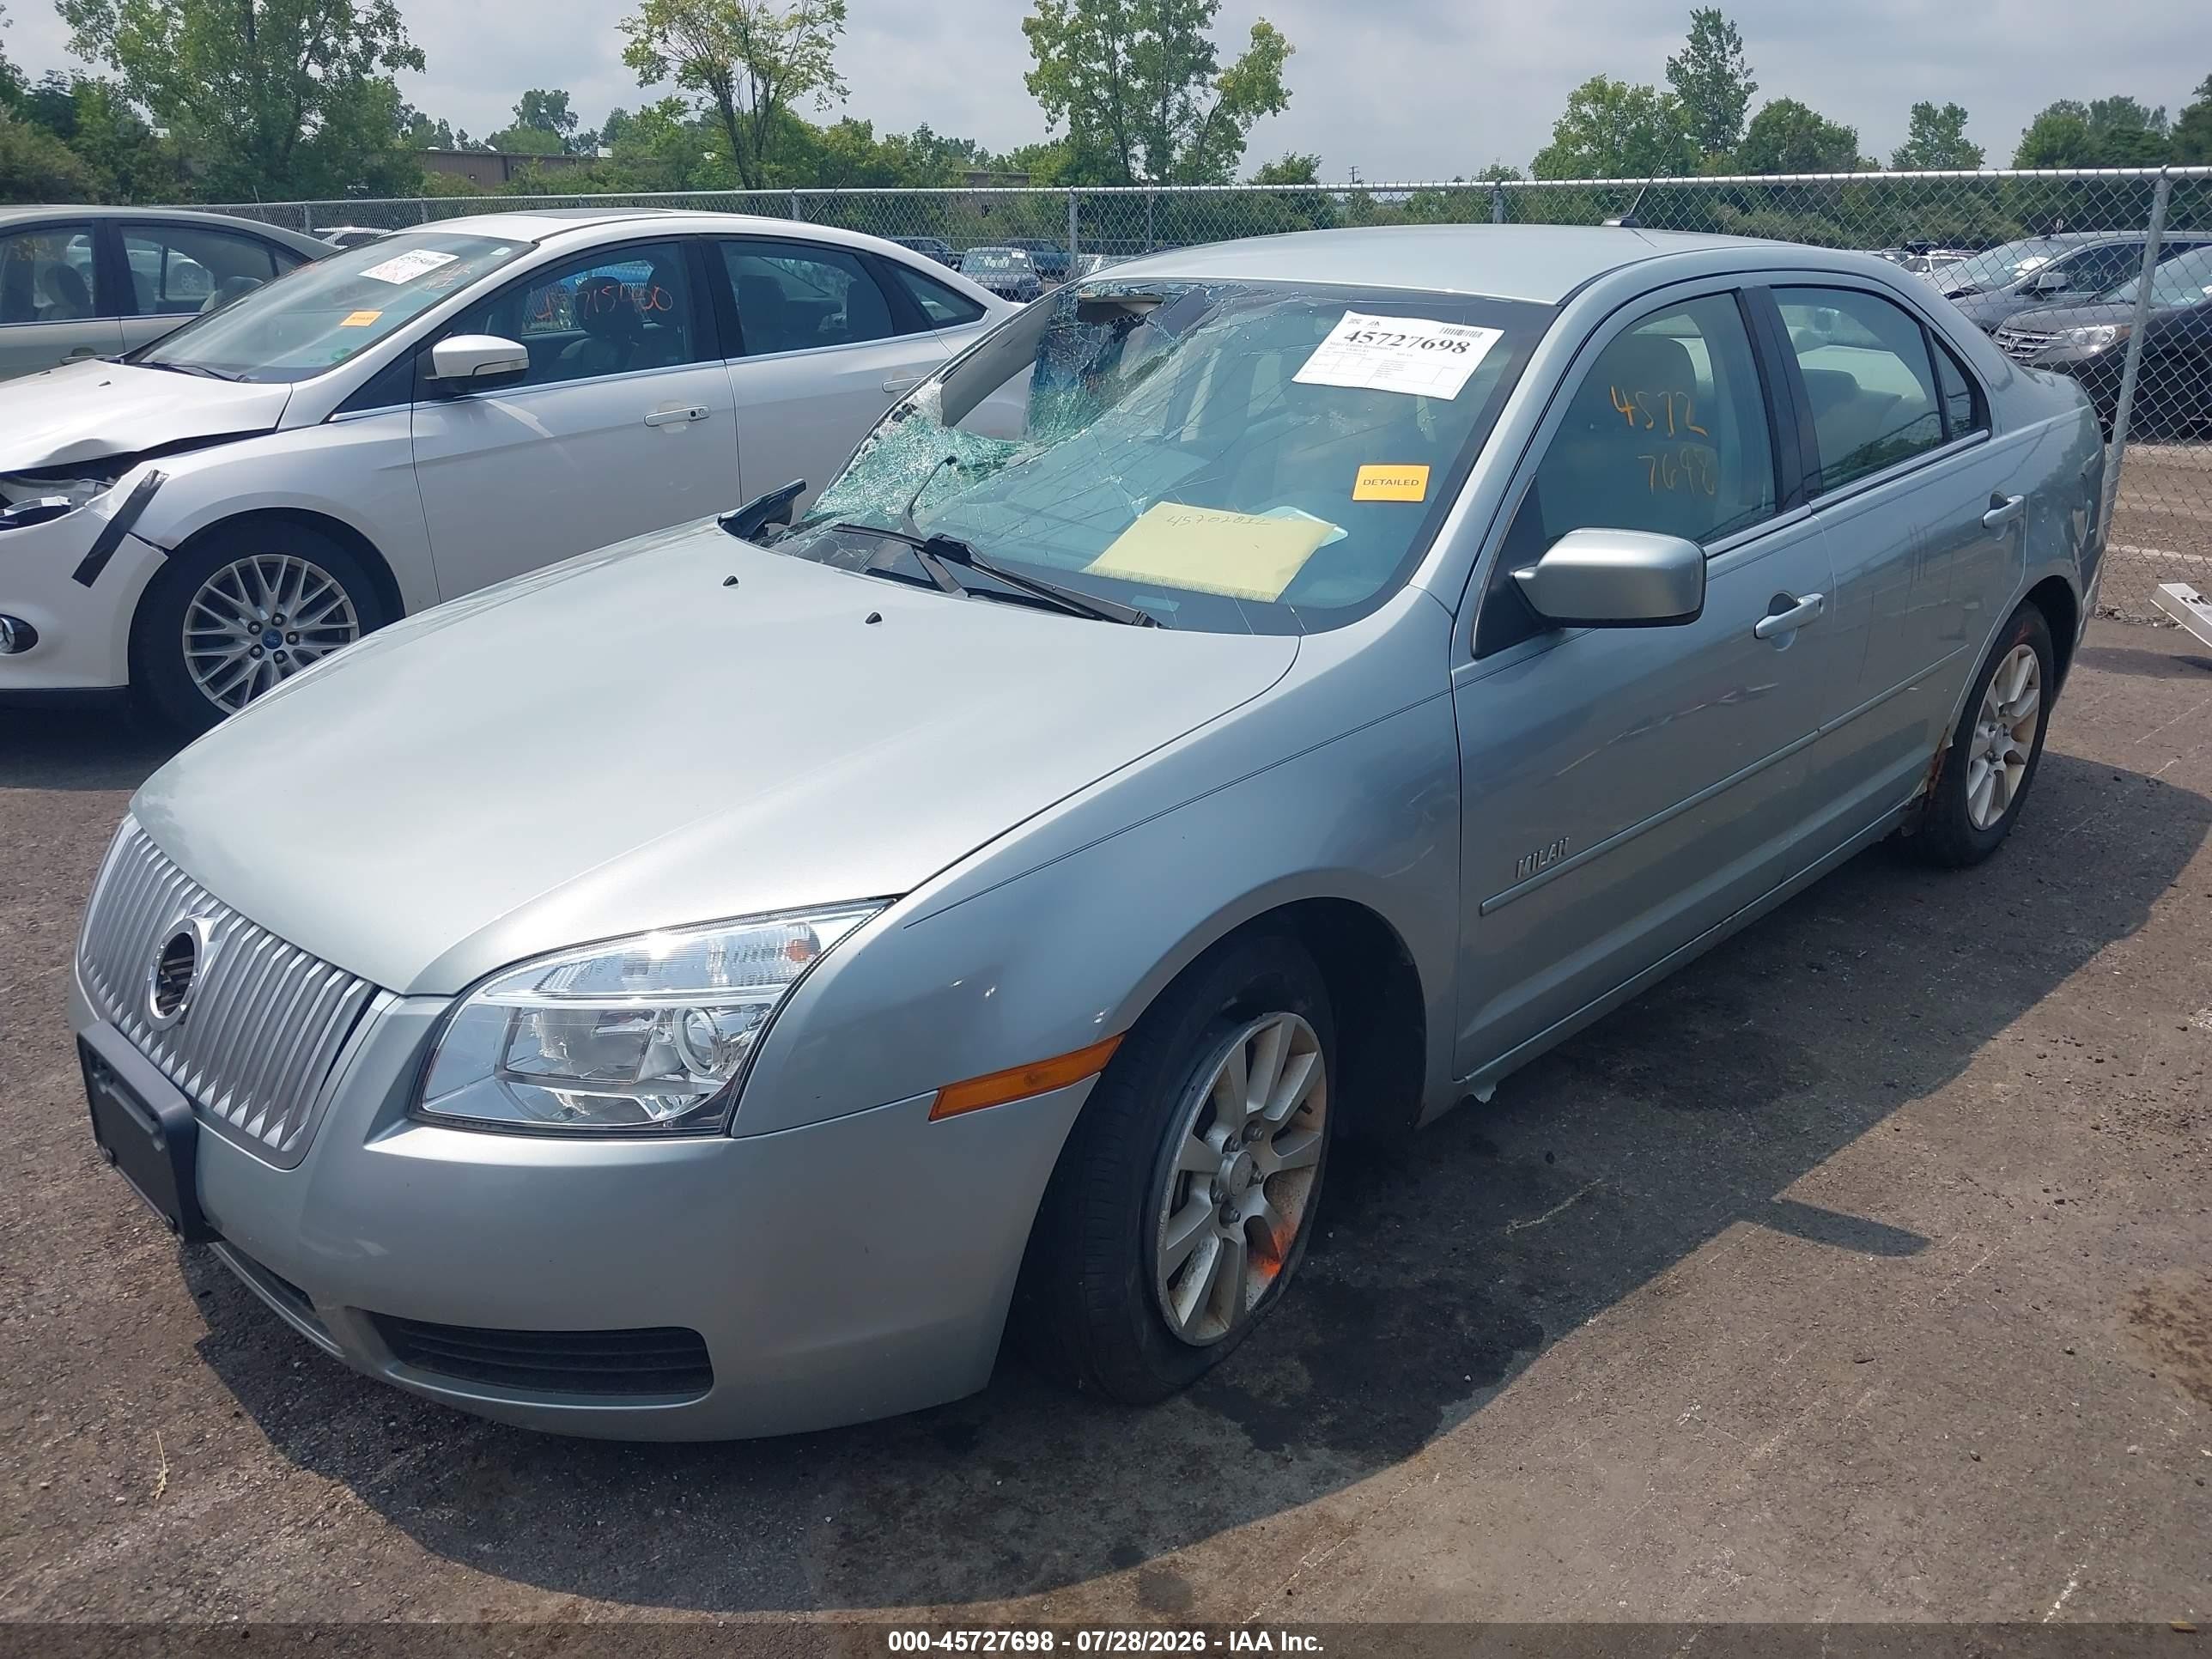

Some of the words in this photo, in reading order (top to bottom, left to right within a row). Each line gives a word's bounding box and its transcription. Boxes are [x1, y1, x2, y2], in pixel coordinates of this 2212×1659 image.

[1344, 330, 1471, 355] 45727698
[1610, 386, 1709, 438] 4572
[1363, 478, 1419, 487] DETAILED
[1516, 836, 1570, 879] MILAN
